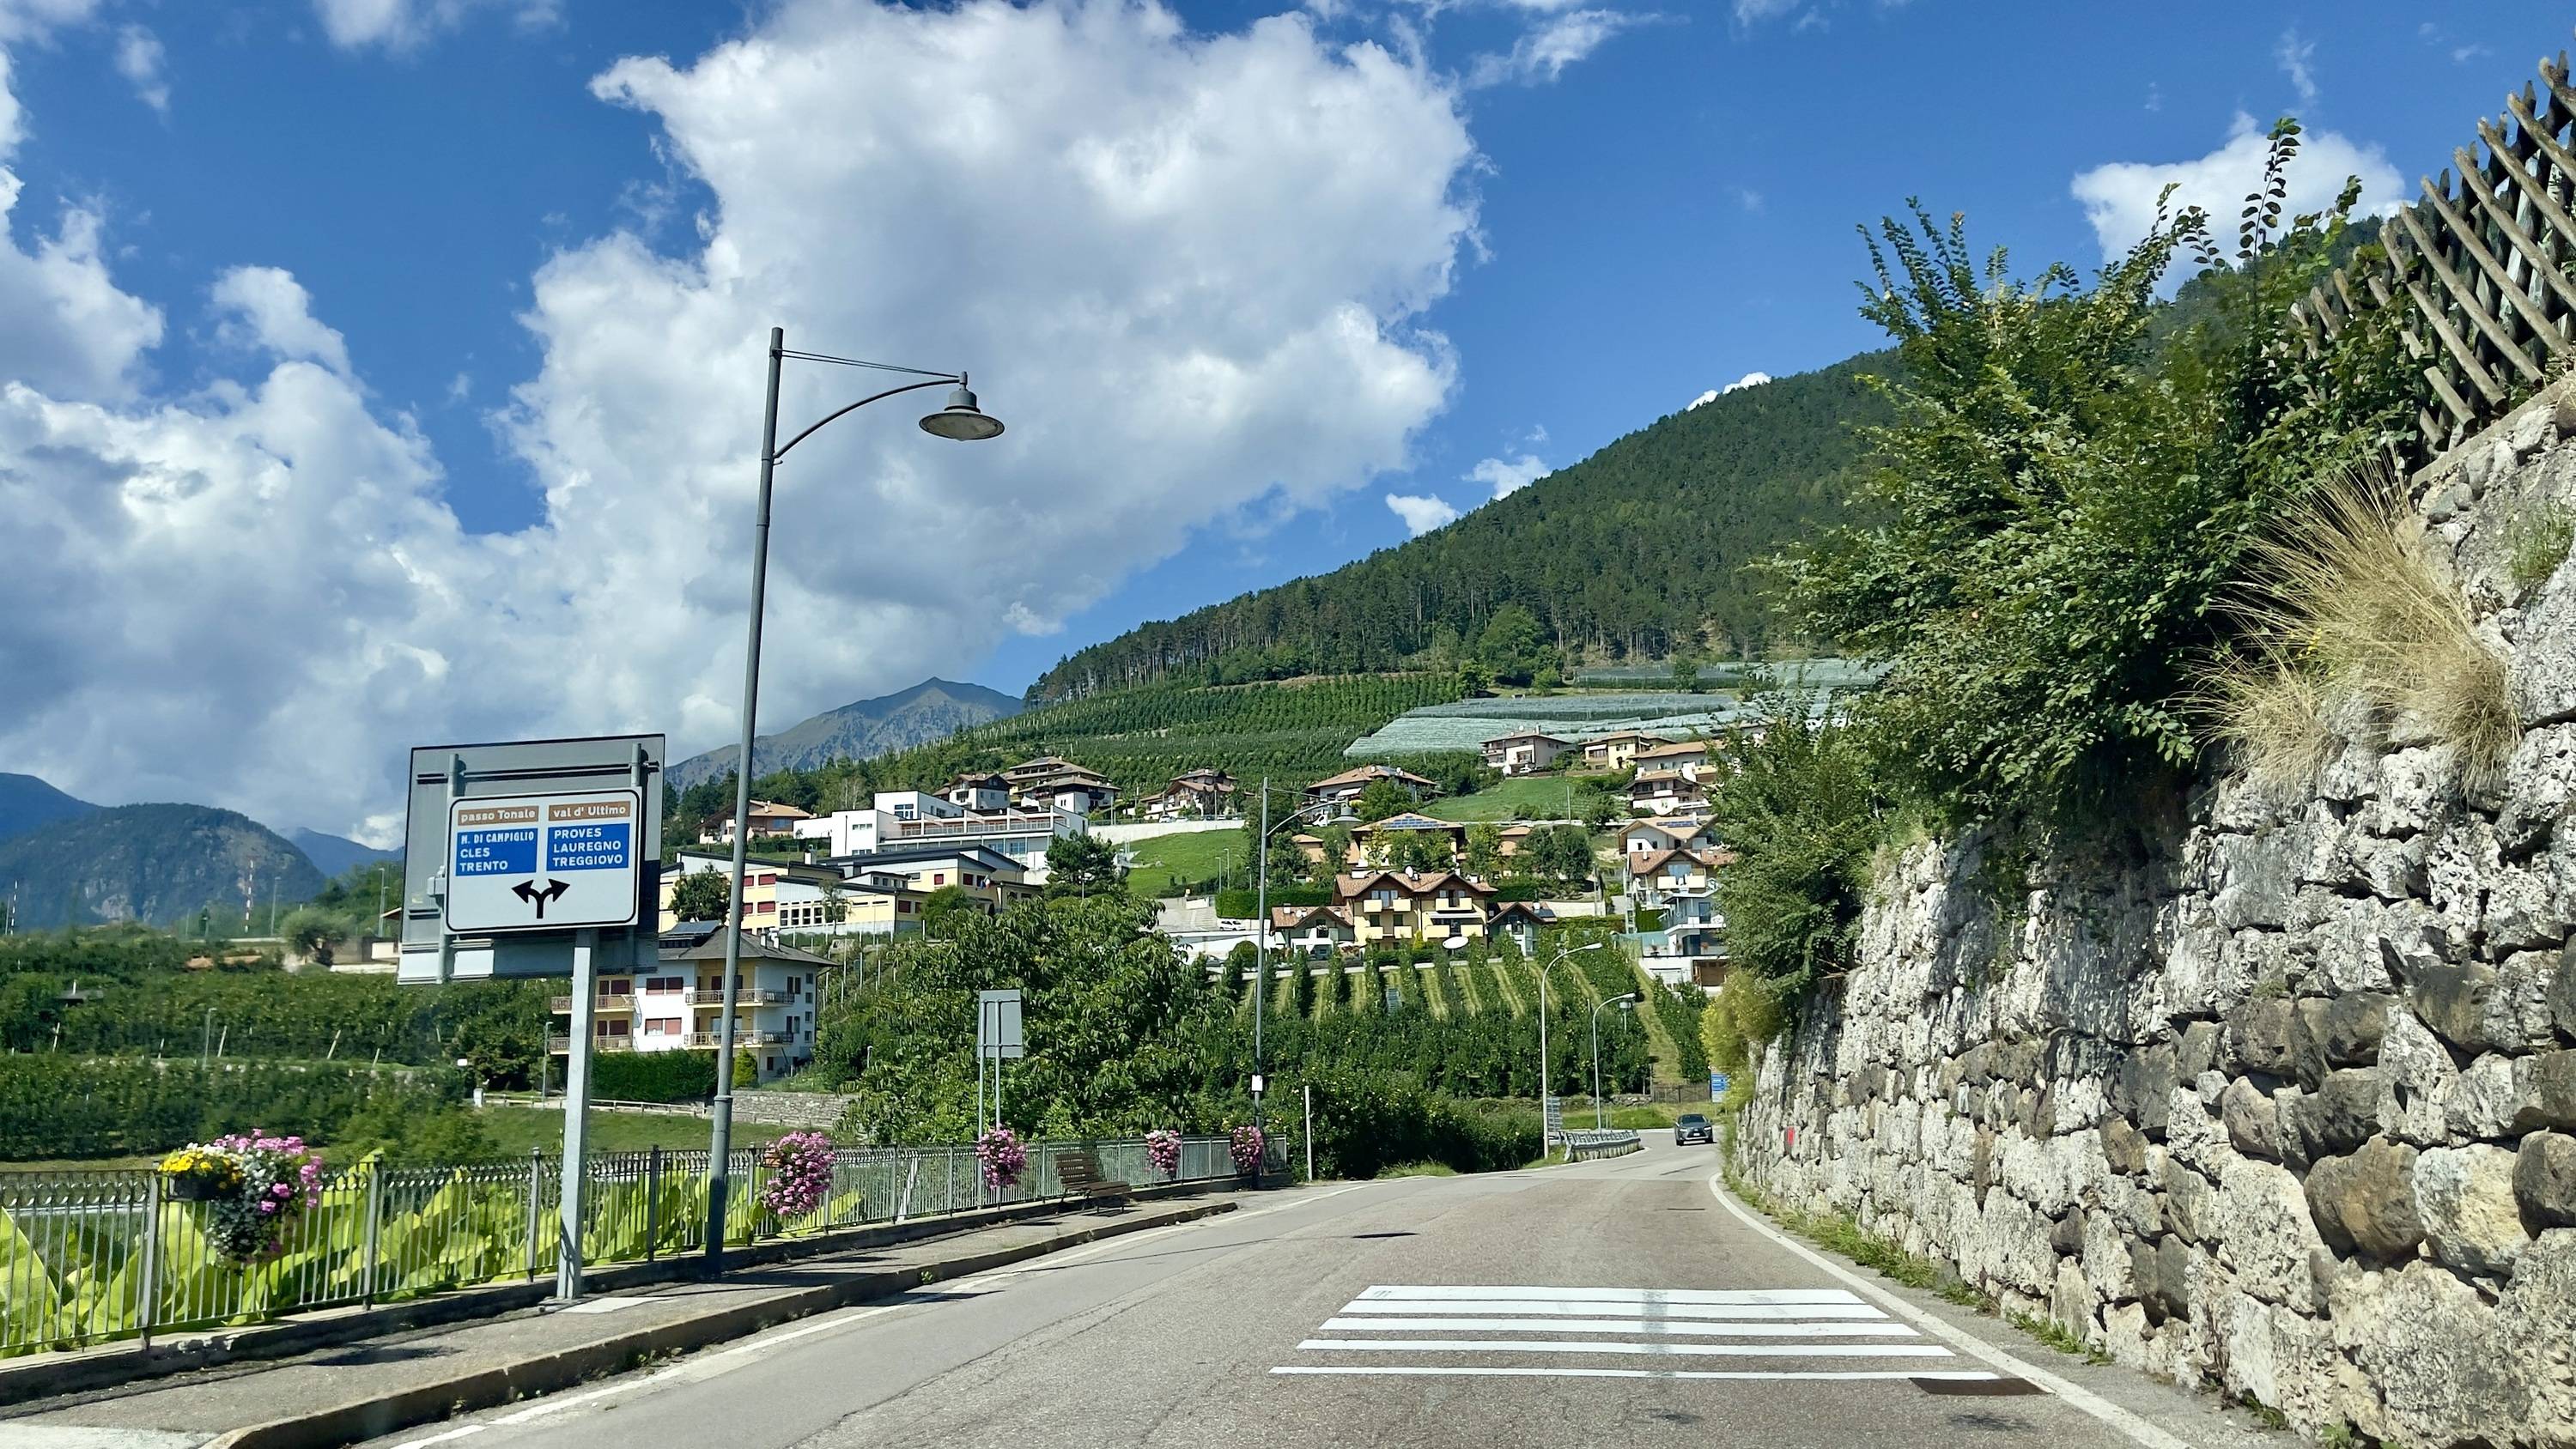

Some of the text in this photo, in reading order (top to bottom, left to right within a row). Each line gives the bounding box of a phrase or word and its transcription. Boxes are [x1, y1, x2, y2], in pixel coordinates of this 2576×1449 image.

[461, 809, 536, 823] passo Tonale
[553, 805, 626, 817] val d' Ultimo
[461, 831, 534, 845] M. DI CAMPIGLIO
[554, 828, 602, 840] PROVES
[460, 847, 490, 858] CLES
[553, 840, 621, 853] LAUREGNO
[459, 860, 508, 872] TRENTO
[552, 854, 623, 866] TREGGIOVO
